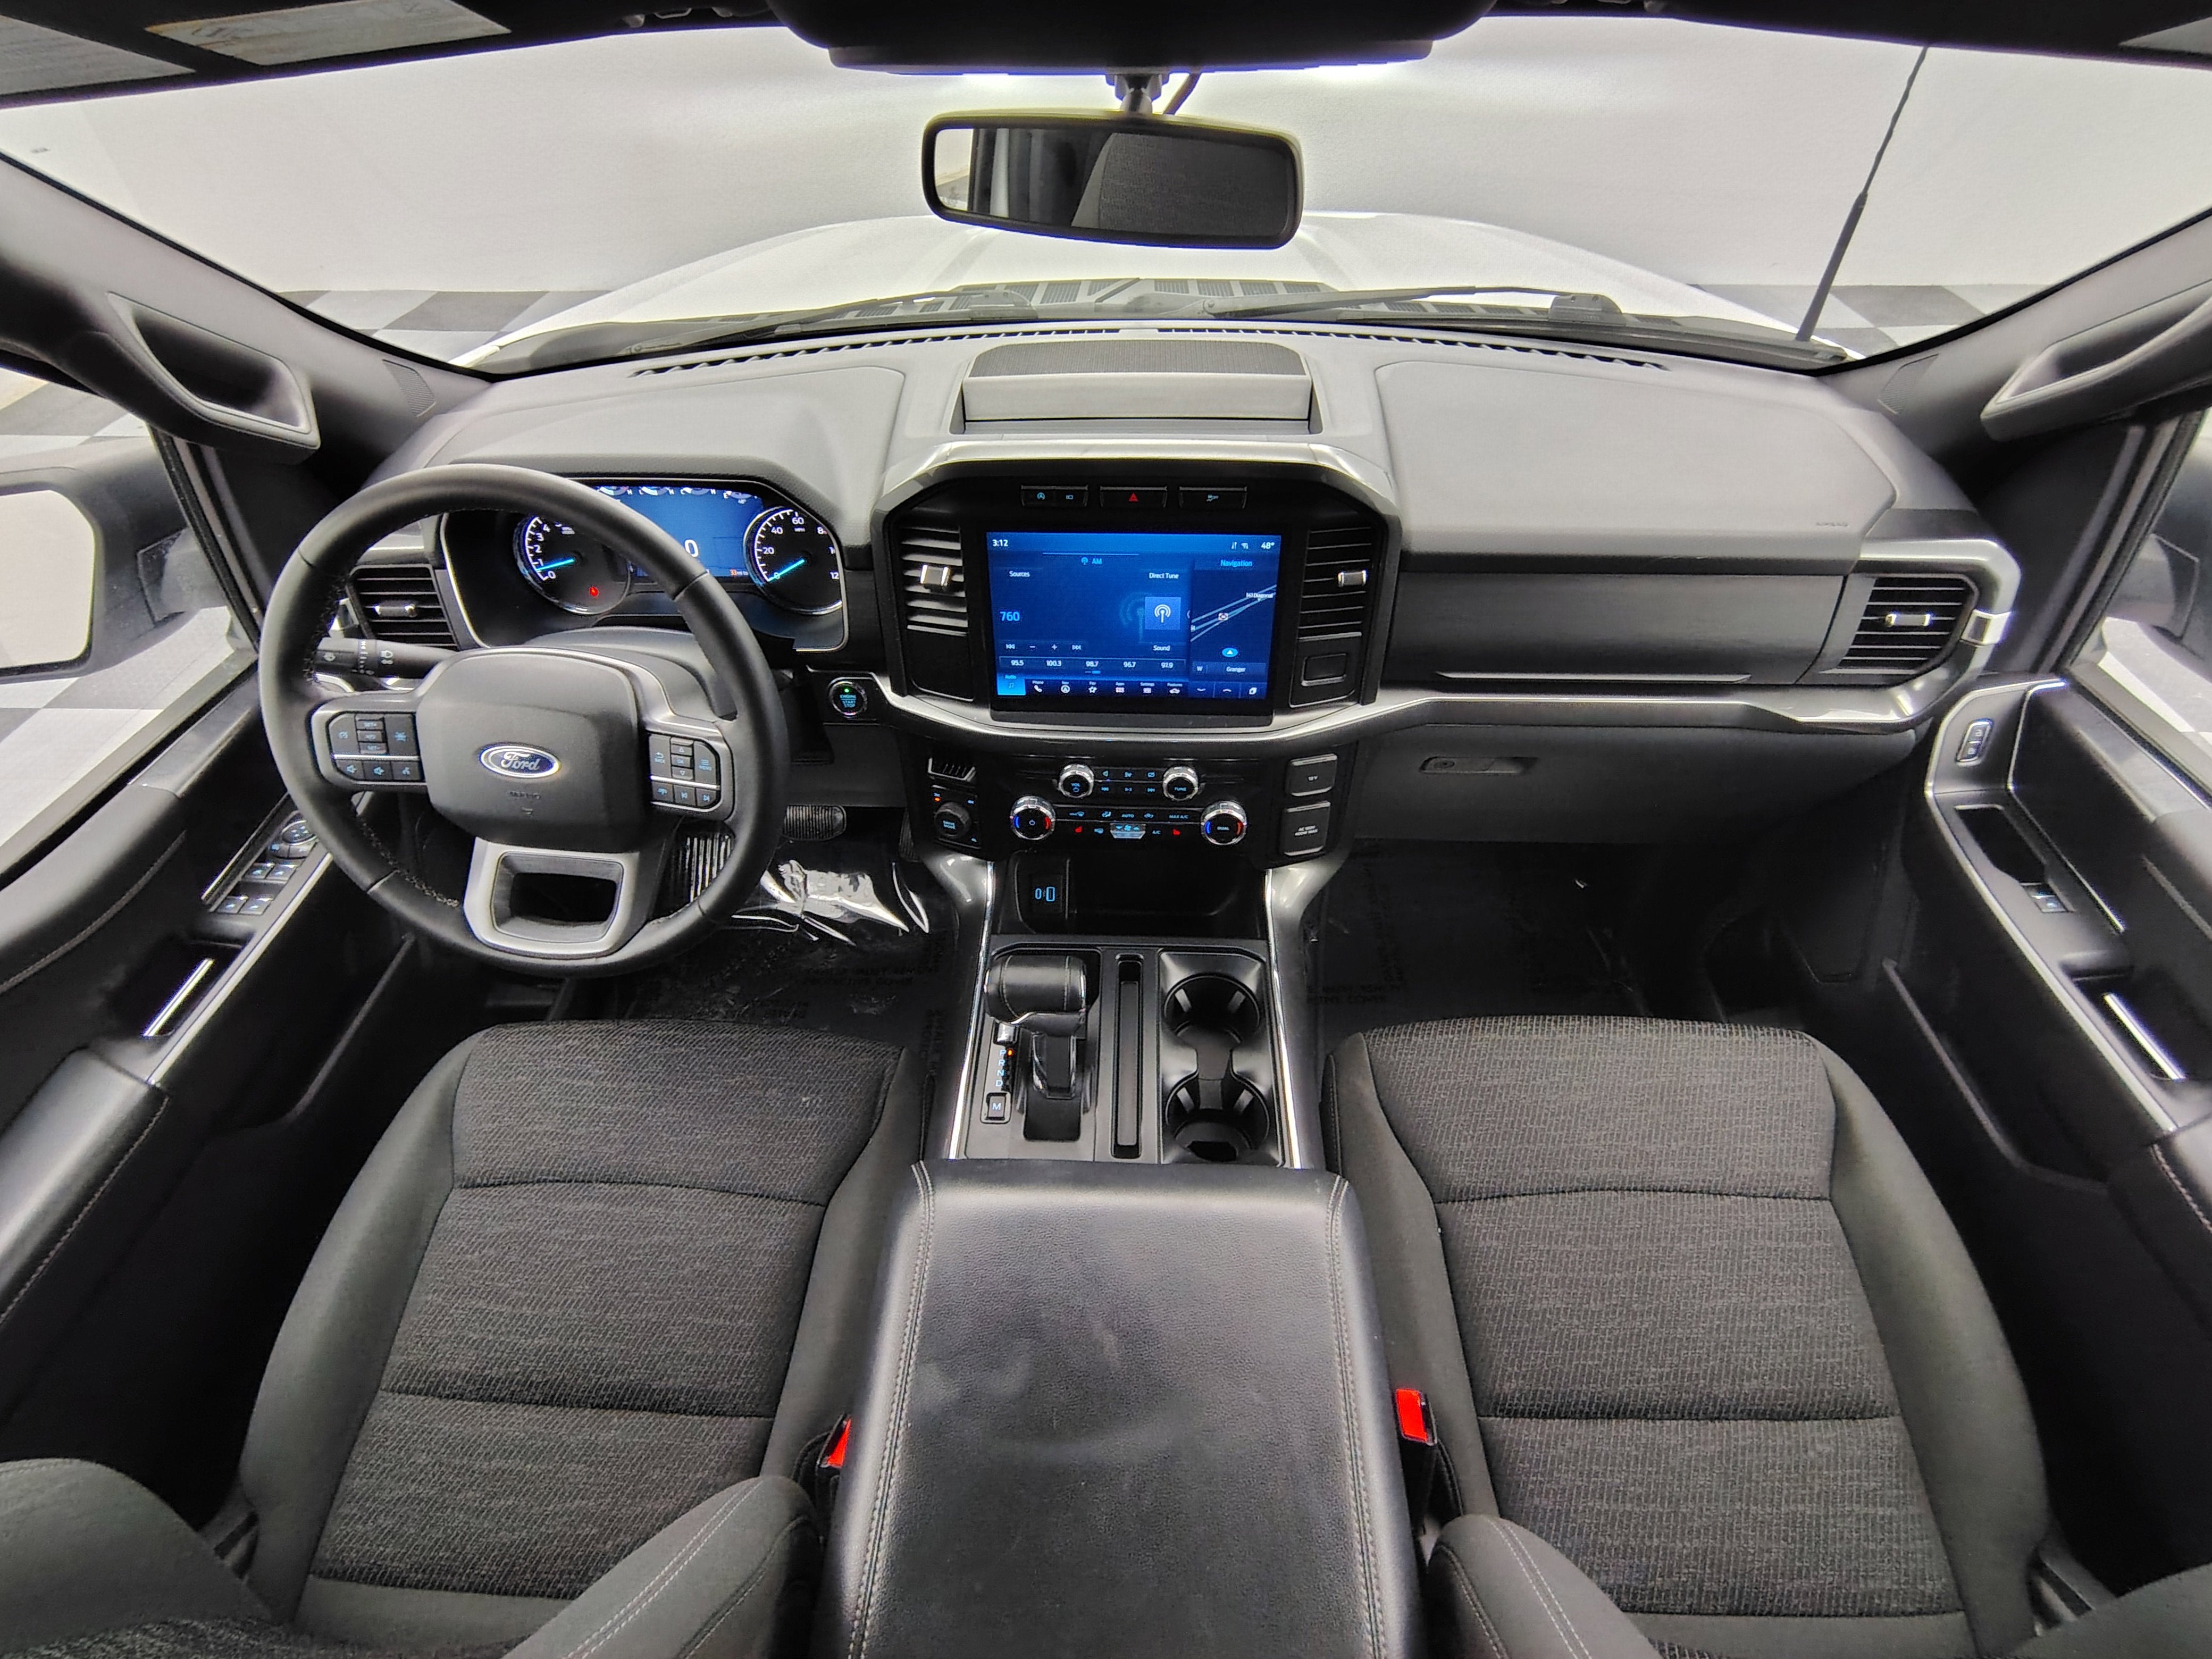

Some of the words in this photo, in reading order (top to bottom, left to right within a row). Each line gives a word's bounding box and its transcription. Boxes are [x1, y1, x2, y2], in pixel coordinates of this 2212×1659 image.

[543, 524, 551, 532] 4
[535, 533, 544, 541] 3
[534, 544, 542, 553] 2
[684, 539, 699, 558] 0
[1000, 611, 1020, 621] 760
[501, 751, 540, 770] Ford
